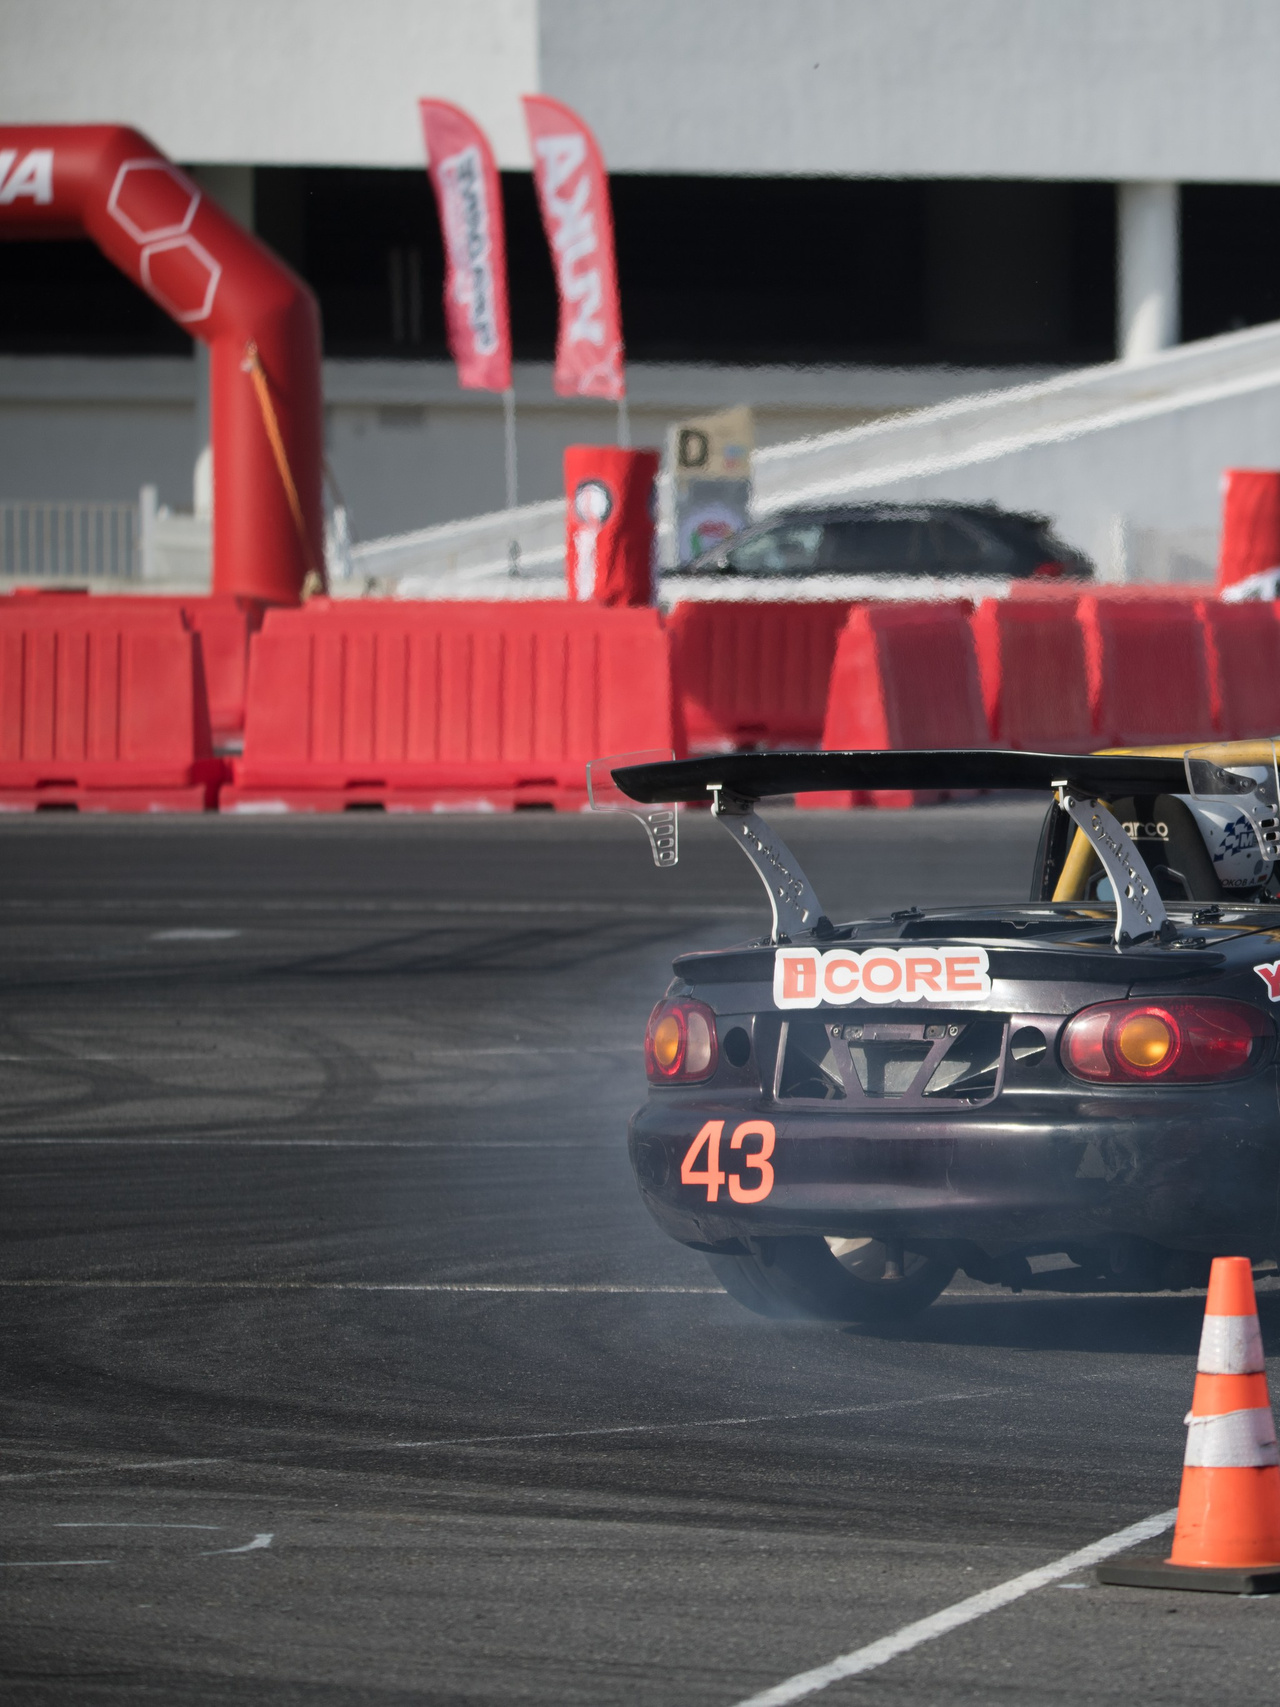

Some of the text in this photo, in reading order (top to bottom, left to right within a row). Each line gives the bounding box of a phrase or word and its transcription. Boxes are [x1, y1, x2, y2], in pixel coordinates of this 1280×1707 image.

[1121, 822, 1169, 837] arco
[1220, 878, 1248, 887] ОКОВ
[681, 1120, 776, 1204] 43
